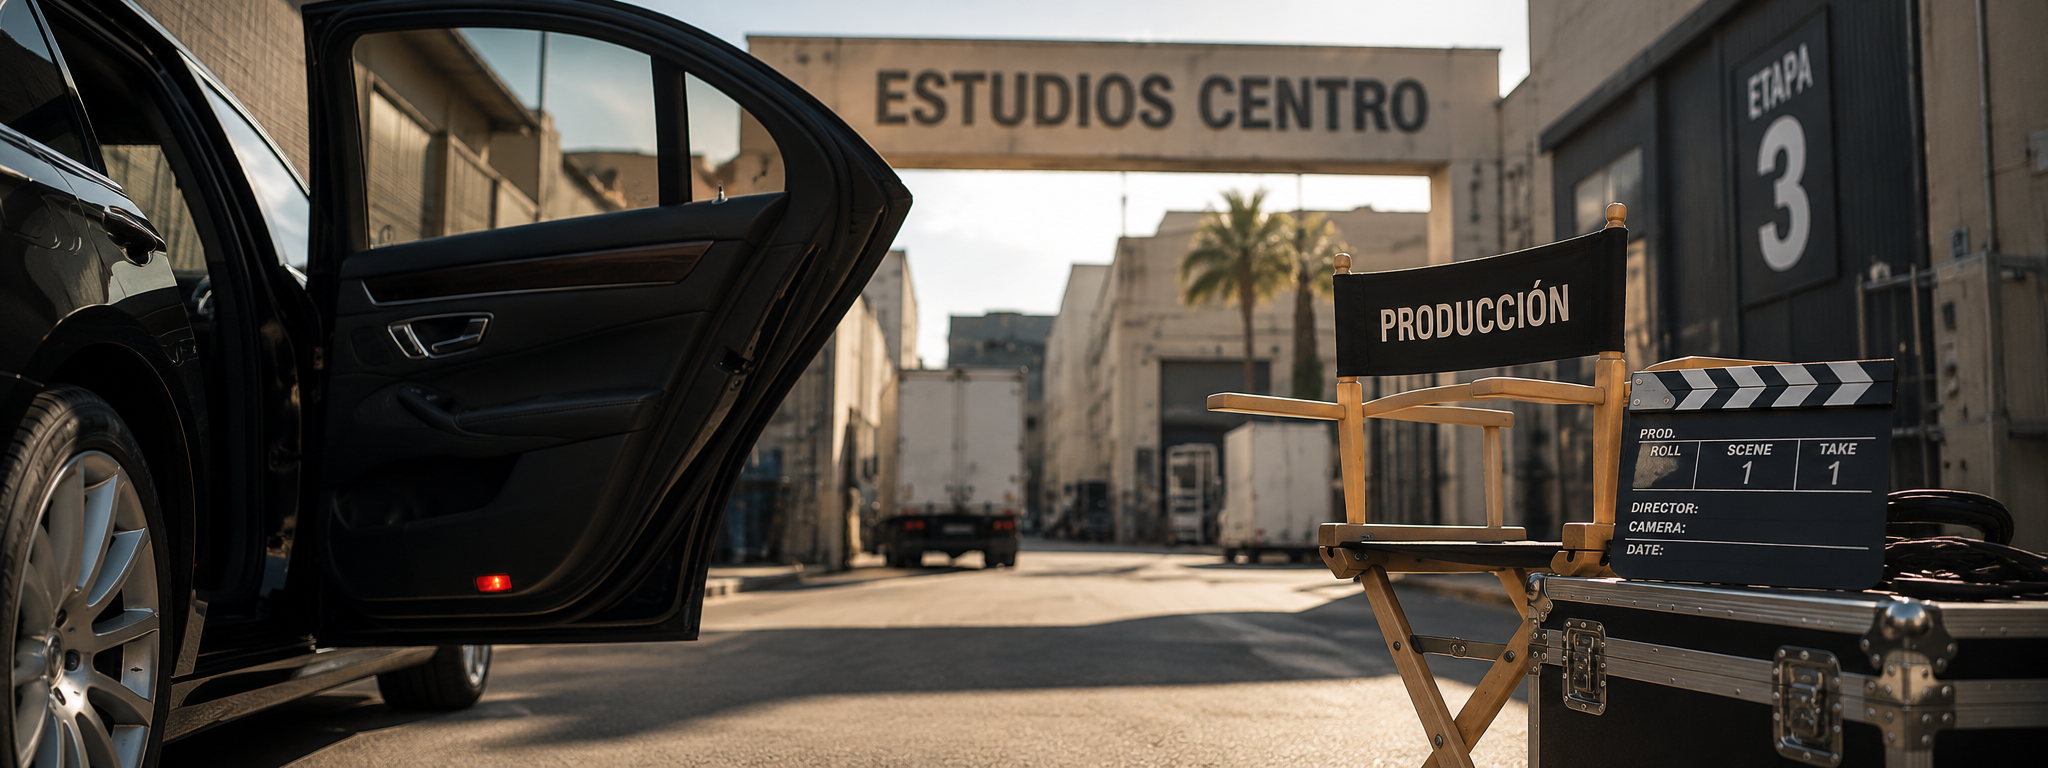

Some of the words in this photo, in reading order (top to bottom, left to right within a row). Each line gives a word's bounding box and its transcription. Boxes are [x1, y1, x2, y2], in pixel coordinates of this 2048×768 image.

[1747, 42, 1814, 120] ETAPA
[876, 69, 1175, 130] ESTUDIOS
[1198, 73, 1429, 134] CENTRO
[1757, 114, 1811, 272] 3
[1380, 279, 1570, 343] PRODUCCIÓN
[1640, 428, 1676, 439] PROD.
[1650, 445, 1681, 456] ROLL
[1727, 444, 1773, 456] SCENE
[1819, 443, 1857, 455] TAKE
[1742, 461, 1752, 485] 1
[1828, 461, 1840, 485] 1
[1631, 502, 1699, 514] DIRECTOR:
[1629, 521, 1686, 534] CAMERA:
[1626, 544, 1664, 556] DATE:
